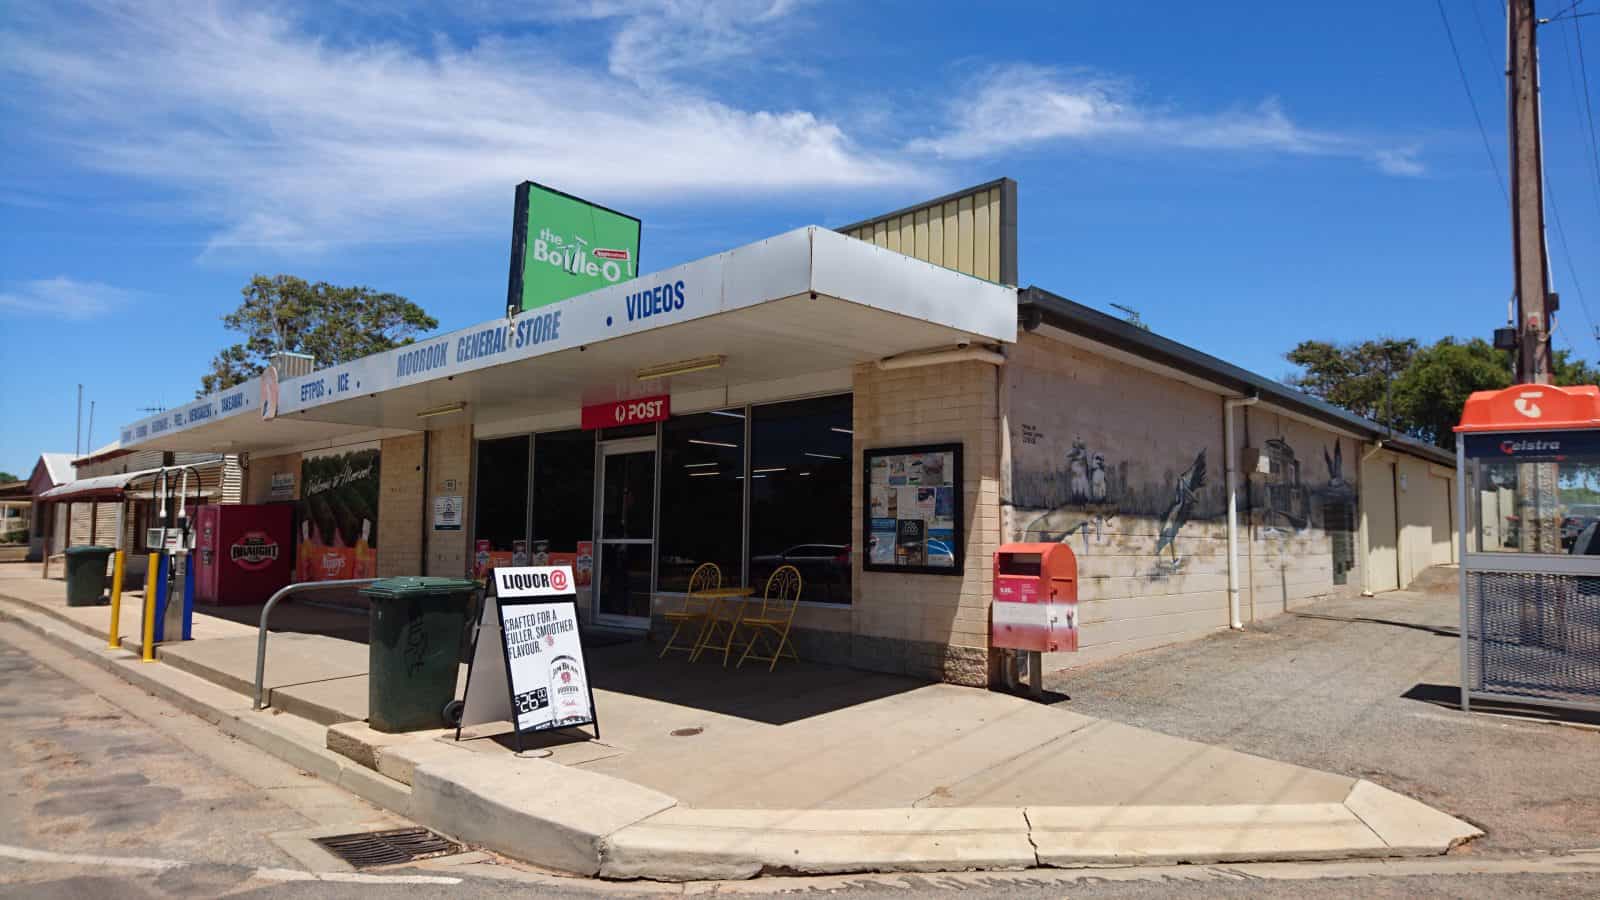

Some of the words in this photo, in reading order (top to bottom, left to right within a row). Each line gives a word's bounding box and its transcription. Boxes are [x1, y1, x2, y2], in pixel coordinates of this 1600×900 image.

[540, 227, 562, 245] the
[626, 280, 685, 322] VIDEOS
[397, 342, 449, 378] MOOROOK
[456, 325, 508, 363] GENERAL
[515, 310, 562, 350] STORE
[300, 378, 325, 401] EFTPOS
[337, 372, 350, 393] ICE
[628, 401, 664, 420] POST
[1500, 440, 1560, 454] Telstra
[504, 613, 536, 632] CRAFTED
[537, 609, 551, 625] FOR
[552, 608, 558, 621] A
[535, 618, 574, 640] SMOOTHER
